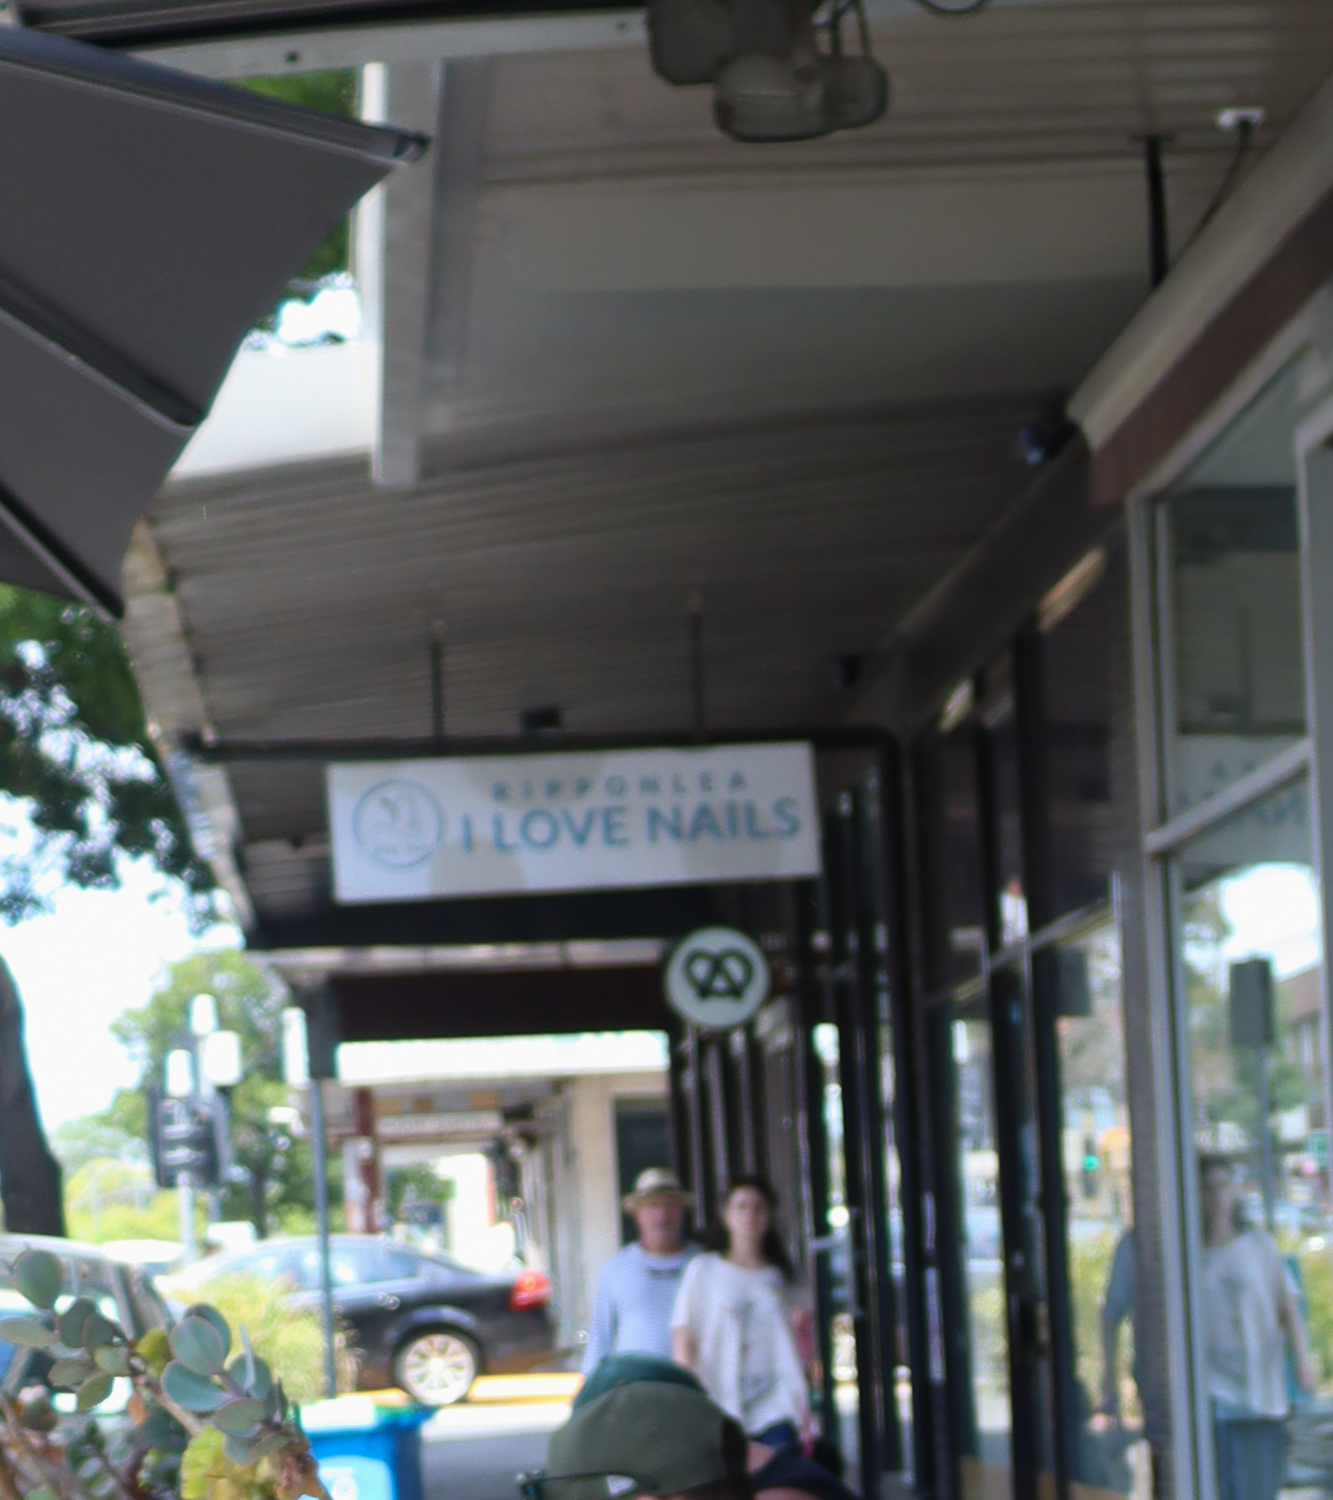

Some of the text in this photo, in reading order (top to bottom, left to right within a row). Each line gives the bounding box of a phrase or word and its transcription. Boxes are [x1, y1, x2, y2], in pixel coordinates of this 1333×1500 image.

[492, 769, 748, 801] RIPPONLEA
[463, 797, 801, 853] I LOVE NAILS
